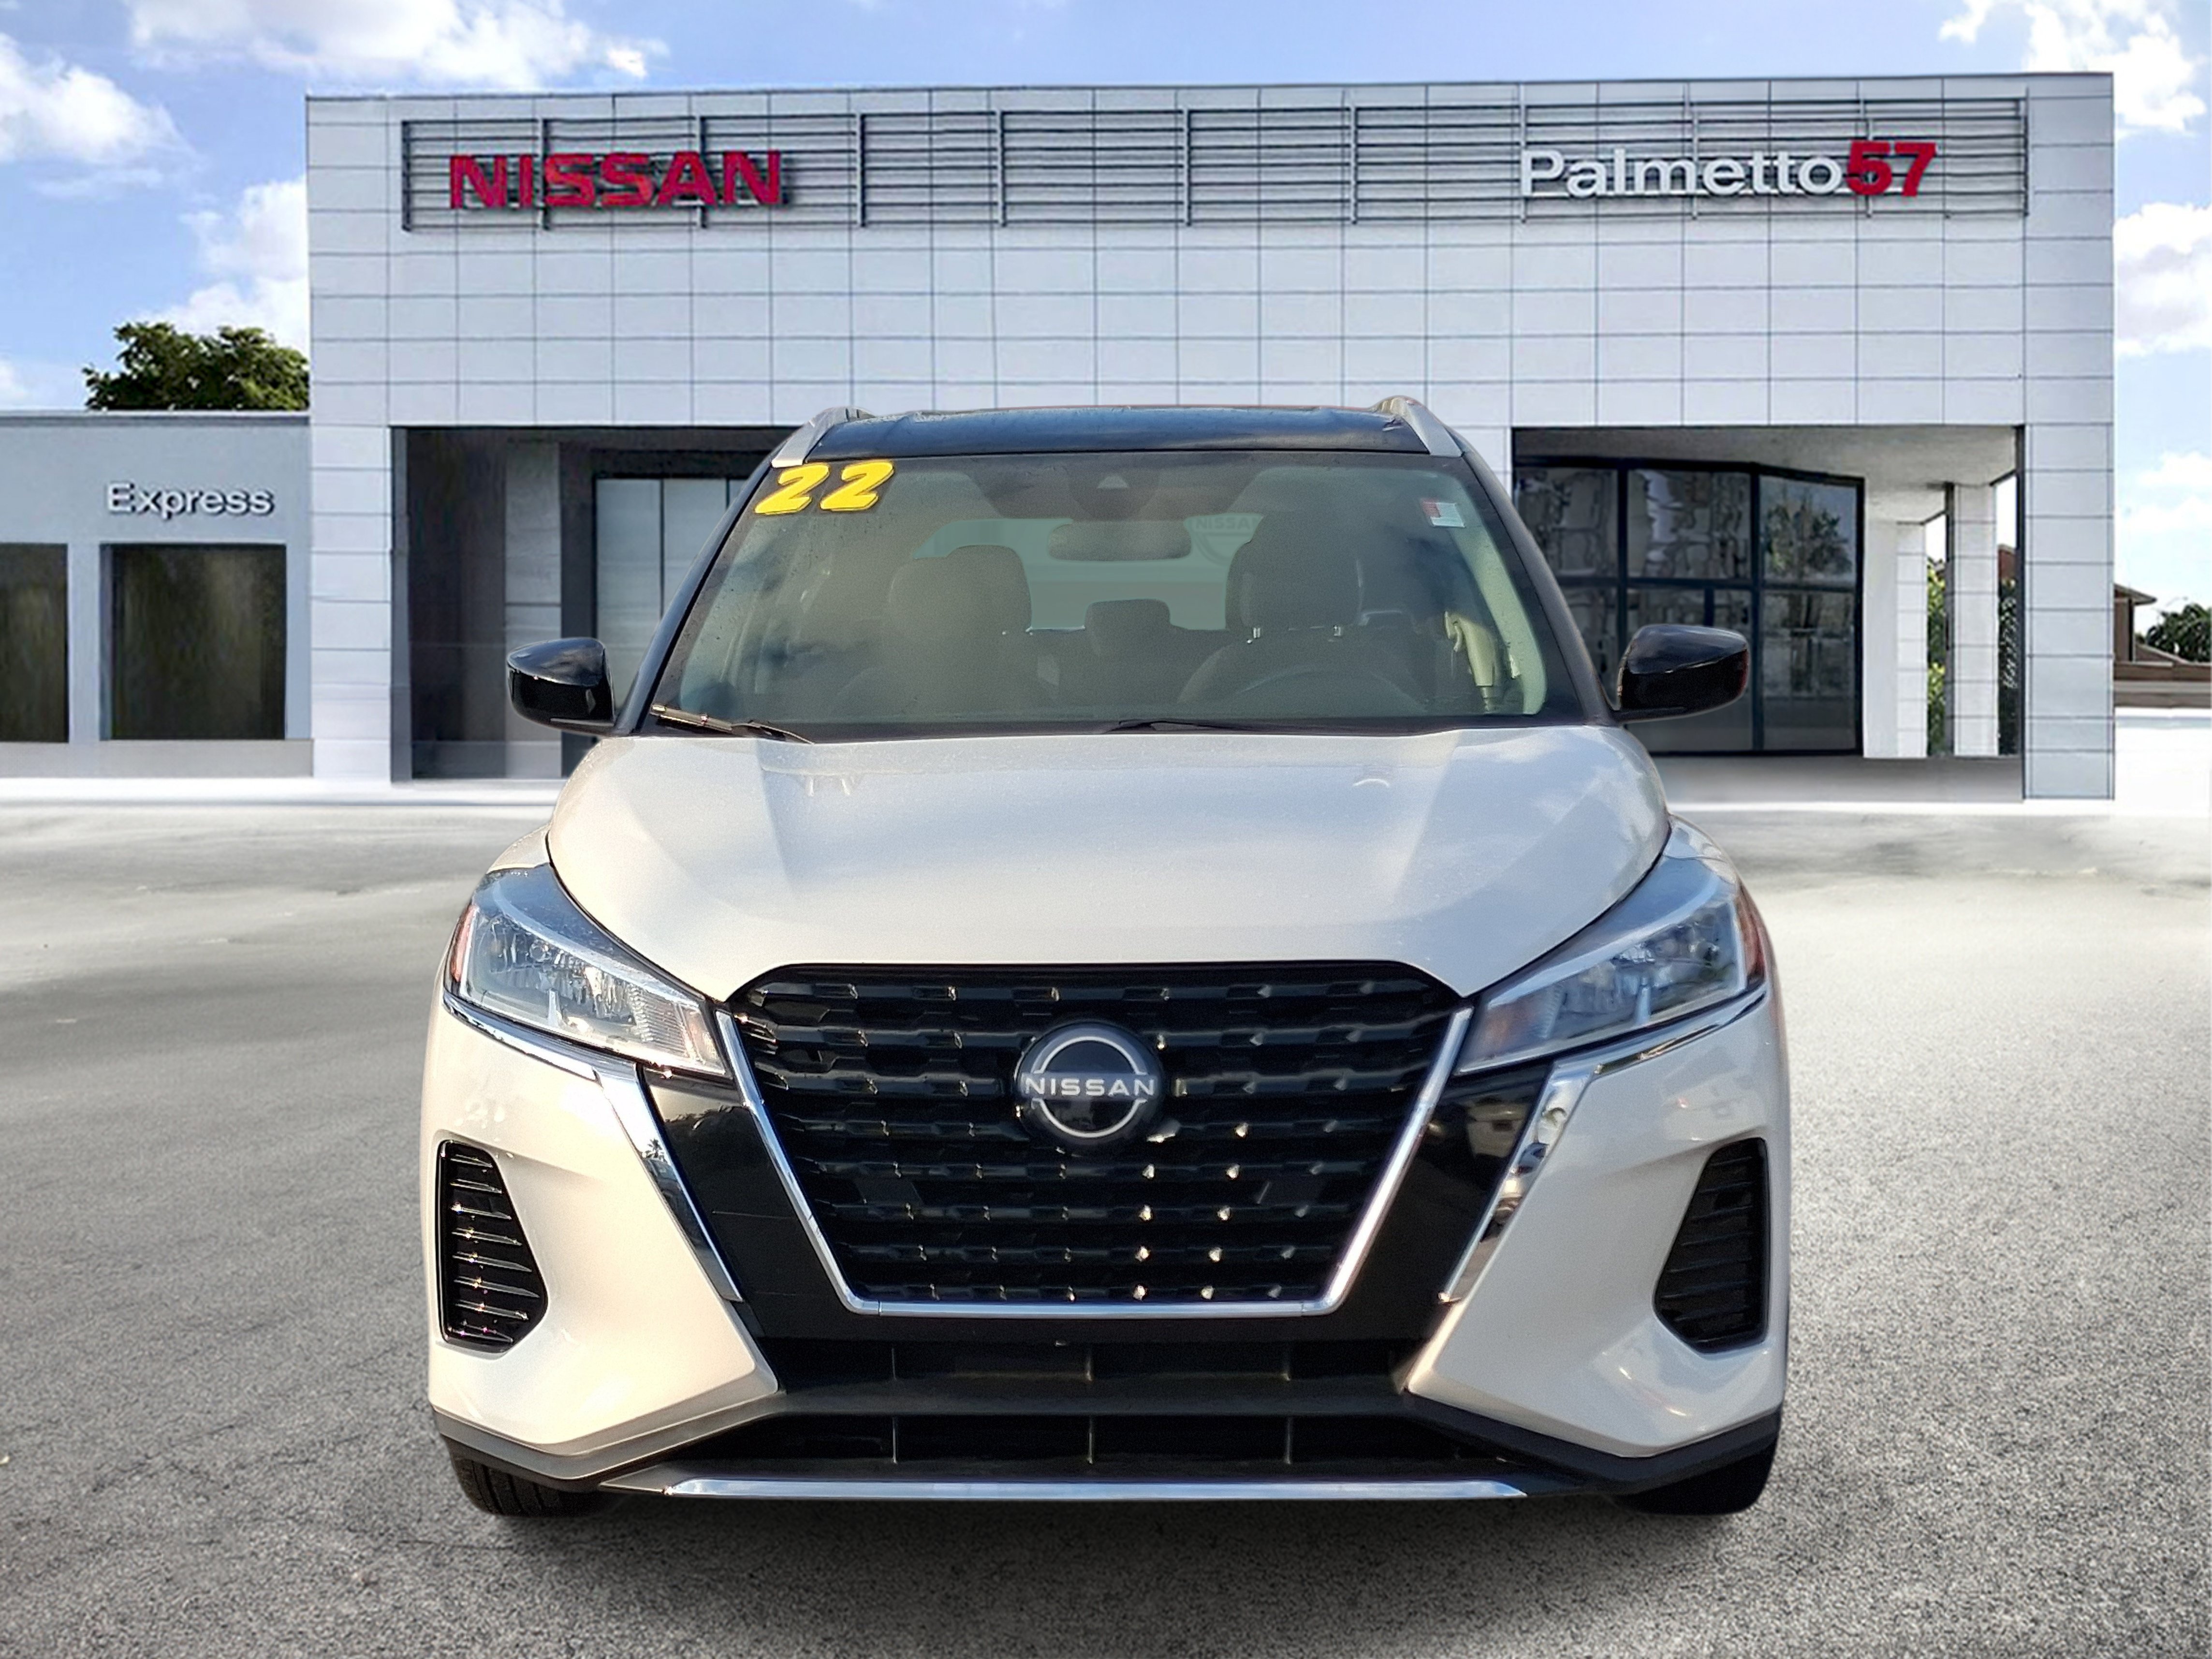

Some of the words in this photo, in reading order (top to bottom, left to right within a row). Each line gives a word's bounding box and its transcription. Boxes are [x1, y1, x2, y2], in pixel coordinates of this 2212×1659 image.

[450, 150, 781, 209] NISSAN
[1521, 141, 1937, 197] Palmetto57
[108, 484, 275, 519] Express
[754, 461, 894, 515] 22
[1025, 1078, 1155, 1096] NISSAN
